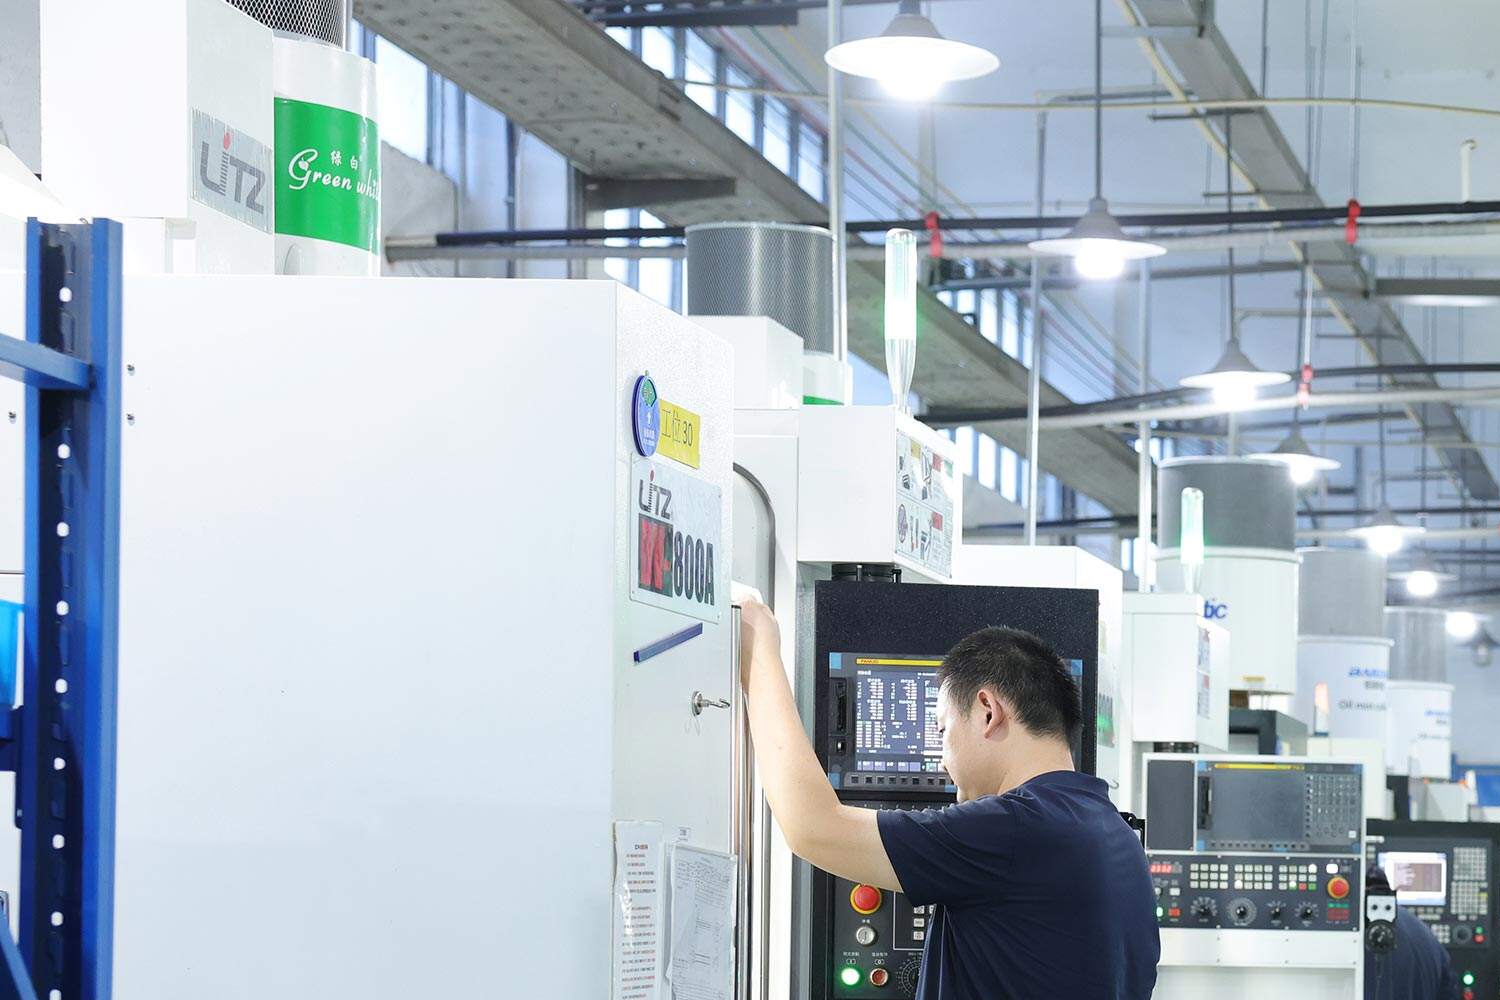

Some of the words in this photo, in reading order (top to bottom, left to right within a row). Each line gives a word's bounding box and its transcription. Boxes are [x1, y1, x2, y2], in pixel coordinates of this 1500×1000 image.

[289, 149, 352, 190] Green
[661, 408, 681, 443] 工位
[683, 420, 693, 447] 30
